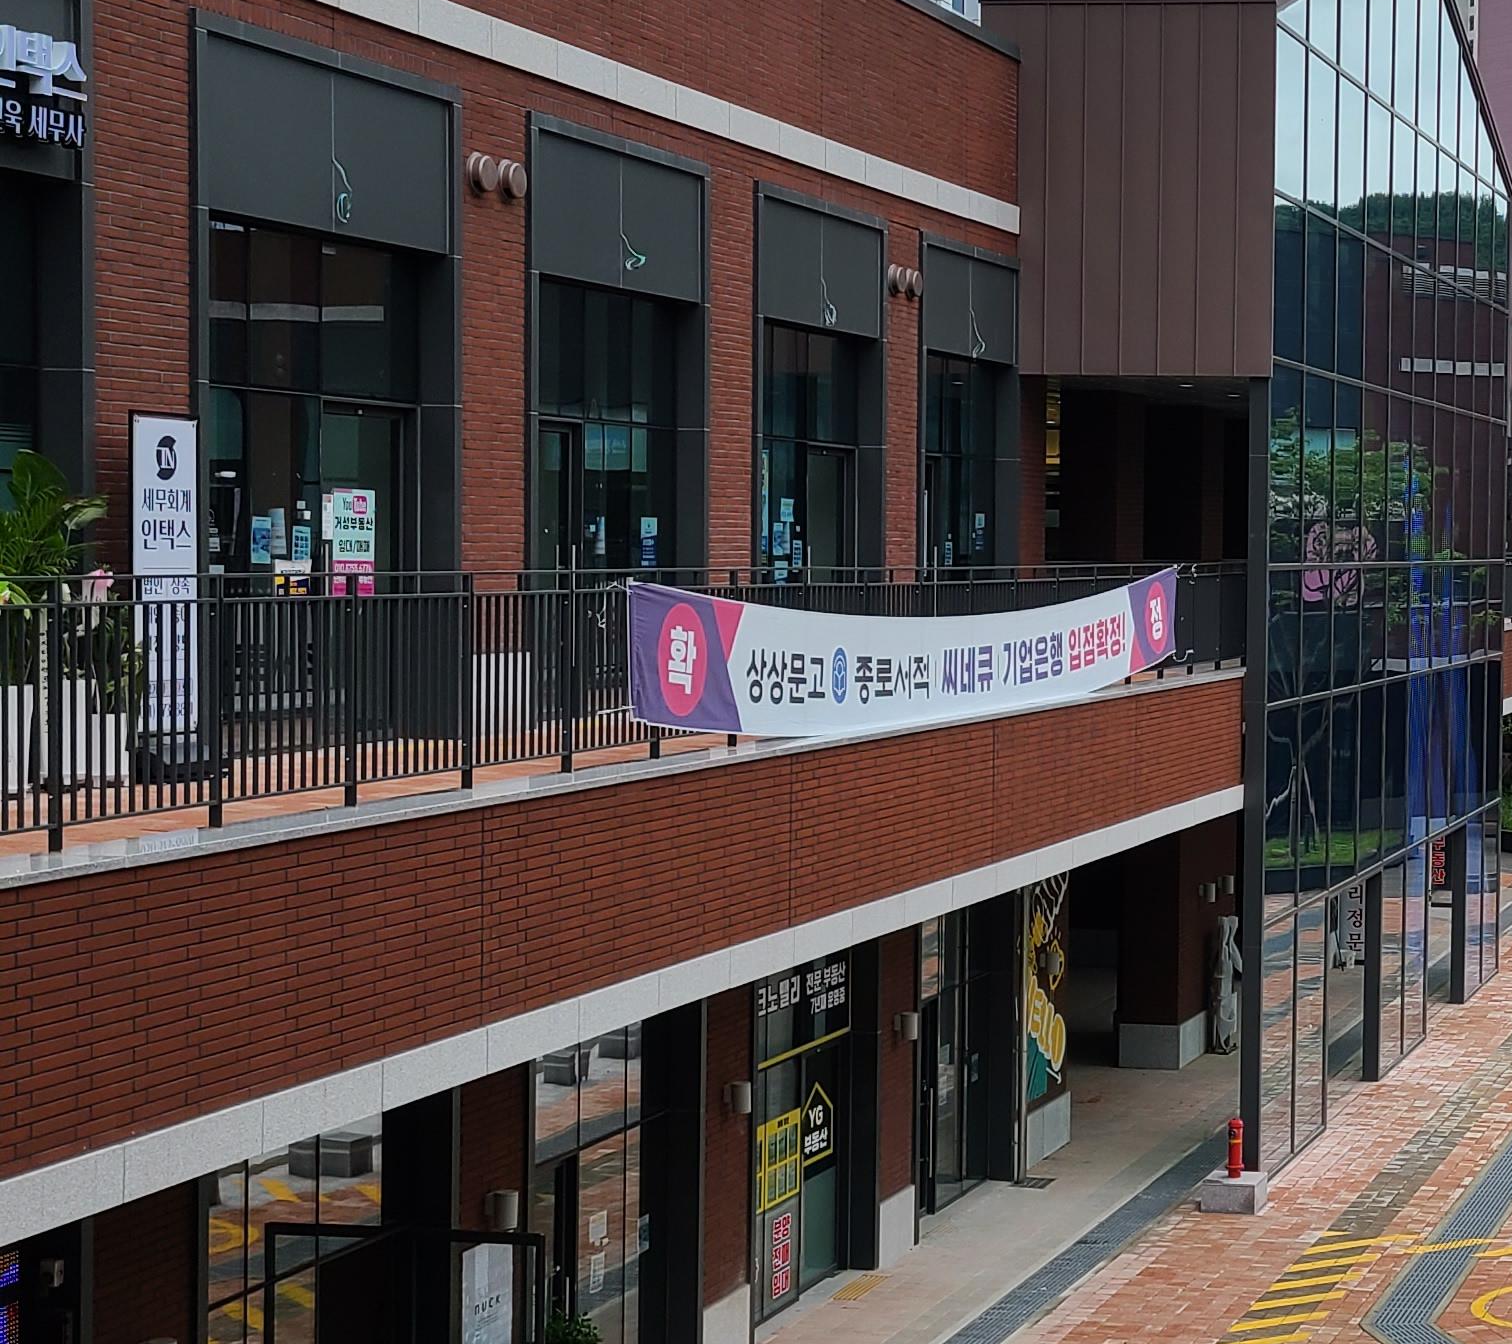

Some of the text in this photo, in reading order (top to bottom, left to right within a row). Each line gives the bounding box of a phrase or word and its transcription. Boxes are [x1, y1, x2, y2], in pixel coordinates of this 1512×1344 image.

[28, 105, 86, 147] 세무사
[142, 488, 191, 513] 세무회계
[141, 519, 191, 550] 인택스
[668, 597, 1163, 705] 확 상상문고 종로서적 씨네큐 기업은행 입점확정! 정
[823, 961, 847, 988] 부동산
[808, 1105, 824, 1129] YG
[804, 1127, 828, 1155] 부동산
[773, 1213, 791, 1244] 분양
[772, 1267, 791, 1300] 임대
